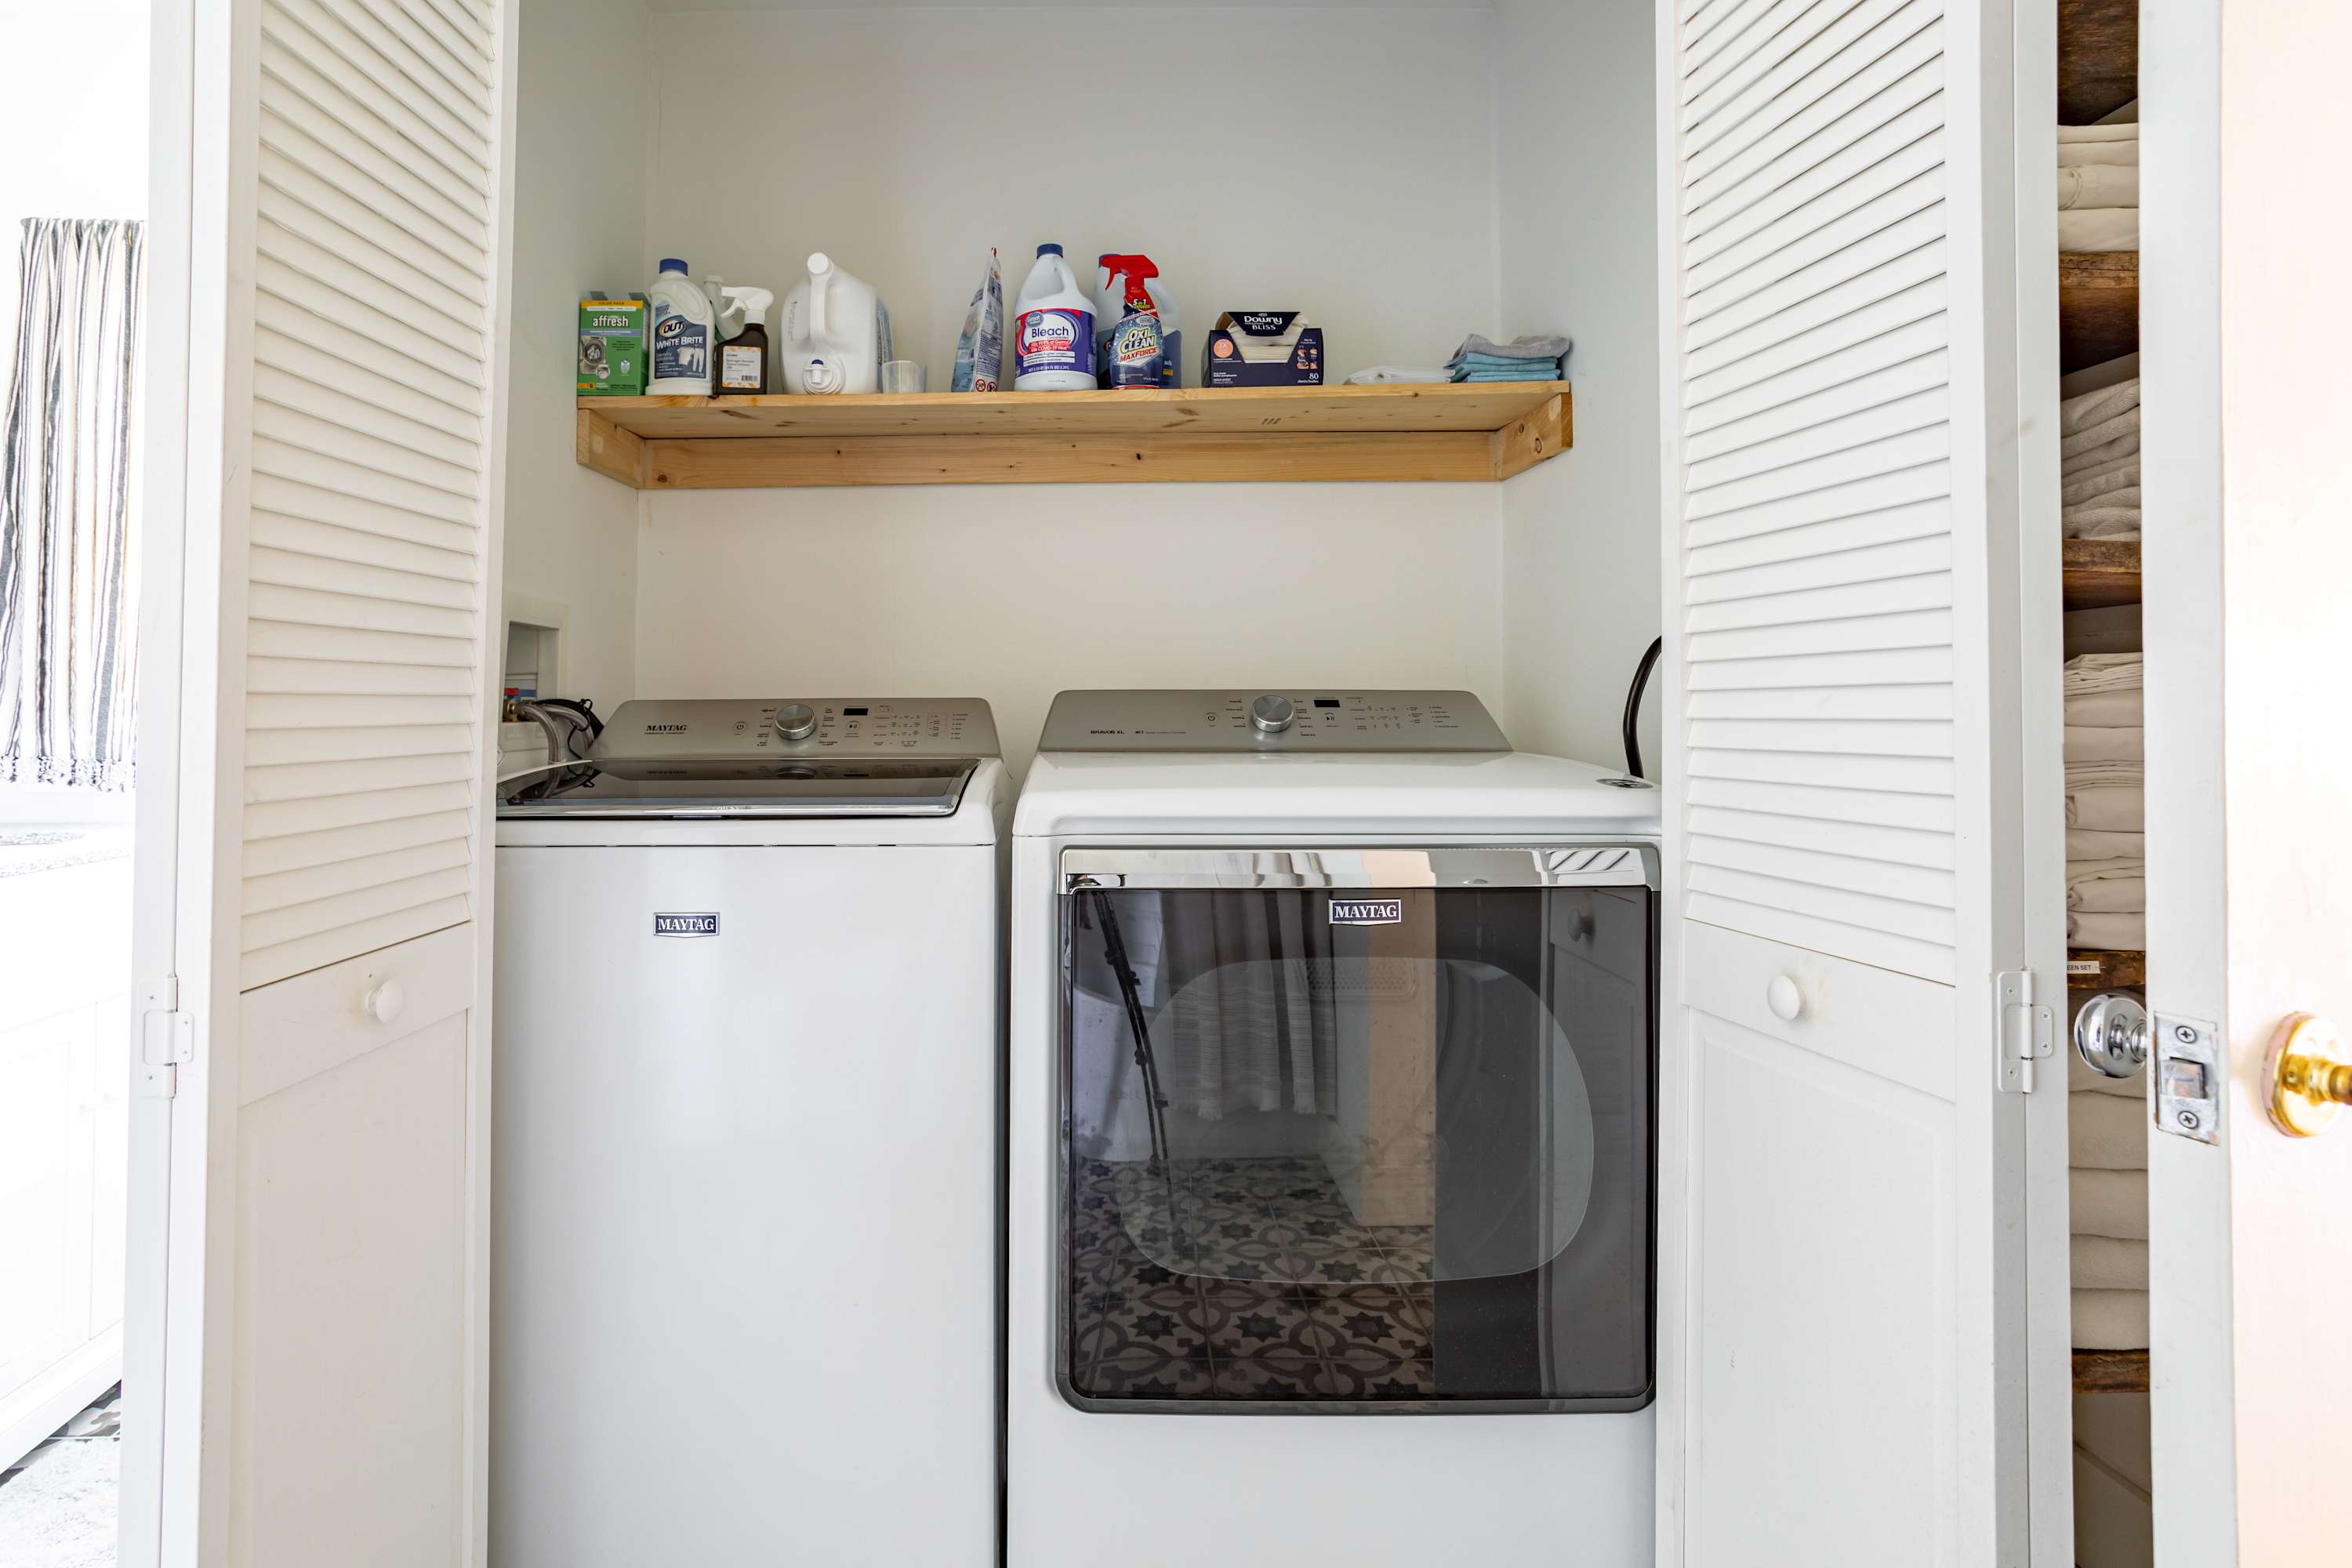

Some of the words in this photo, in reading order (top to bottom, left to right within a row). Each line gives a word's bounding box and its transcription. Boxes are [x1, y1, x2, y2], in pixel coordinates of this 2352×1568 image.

[593, 315, 629, 327] affresh
[1243, 315, 1283, 325] Downy
[663, 321, 684, 334] OUT
[1032, 326, 1069, 338] Bleach
[1128, 328, 1149, 341] OXI
[656, 337, 681, 350] WHITE
[681, 336, 704, 345] BRITE
[1120, 336, 1156, 354] CLEAN
[1120, 347, 1158, 362] MAXFORCE
[1334, 905, 1397, 918] MAYTAG
[658, 918, 715, 931] MAYTAG
